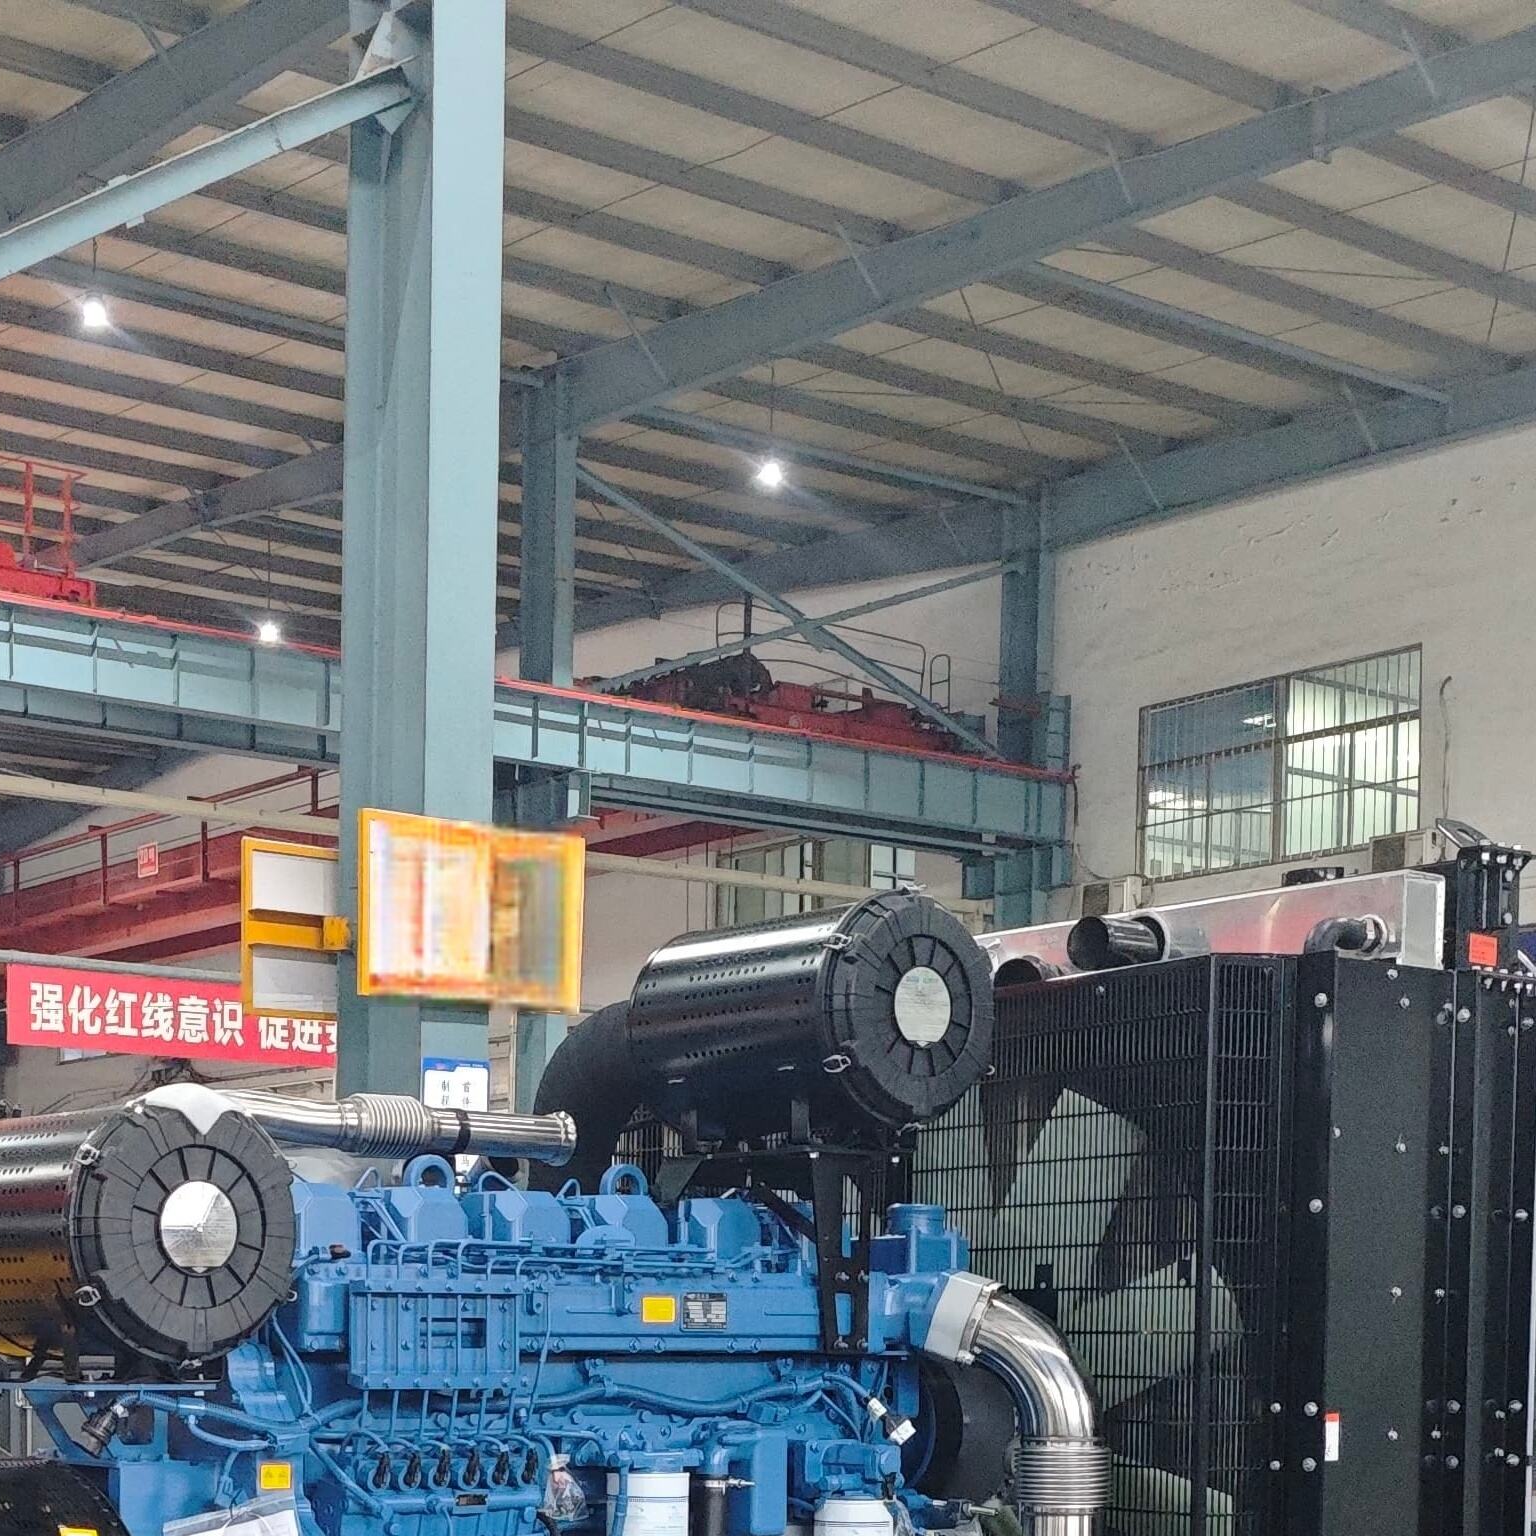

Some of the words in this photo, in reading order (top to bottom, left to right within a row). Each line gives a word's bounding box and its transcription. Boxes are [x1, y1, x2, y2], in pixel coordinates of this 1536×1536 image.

[29, 981, 244, 1047] 强化红线意识
